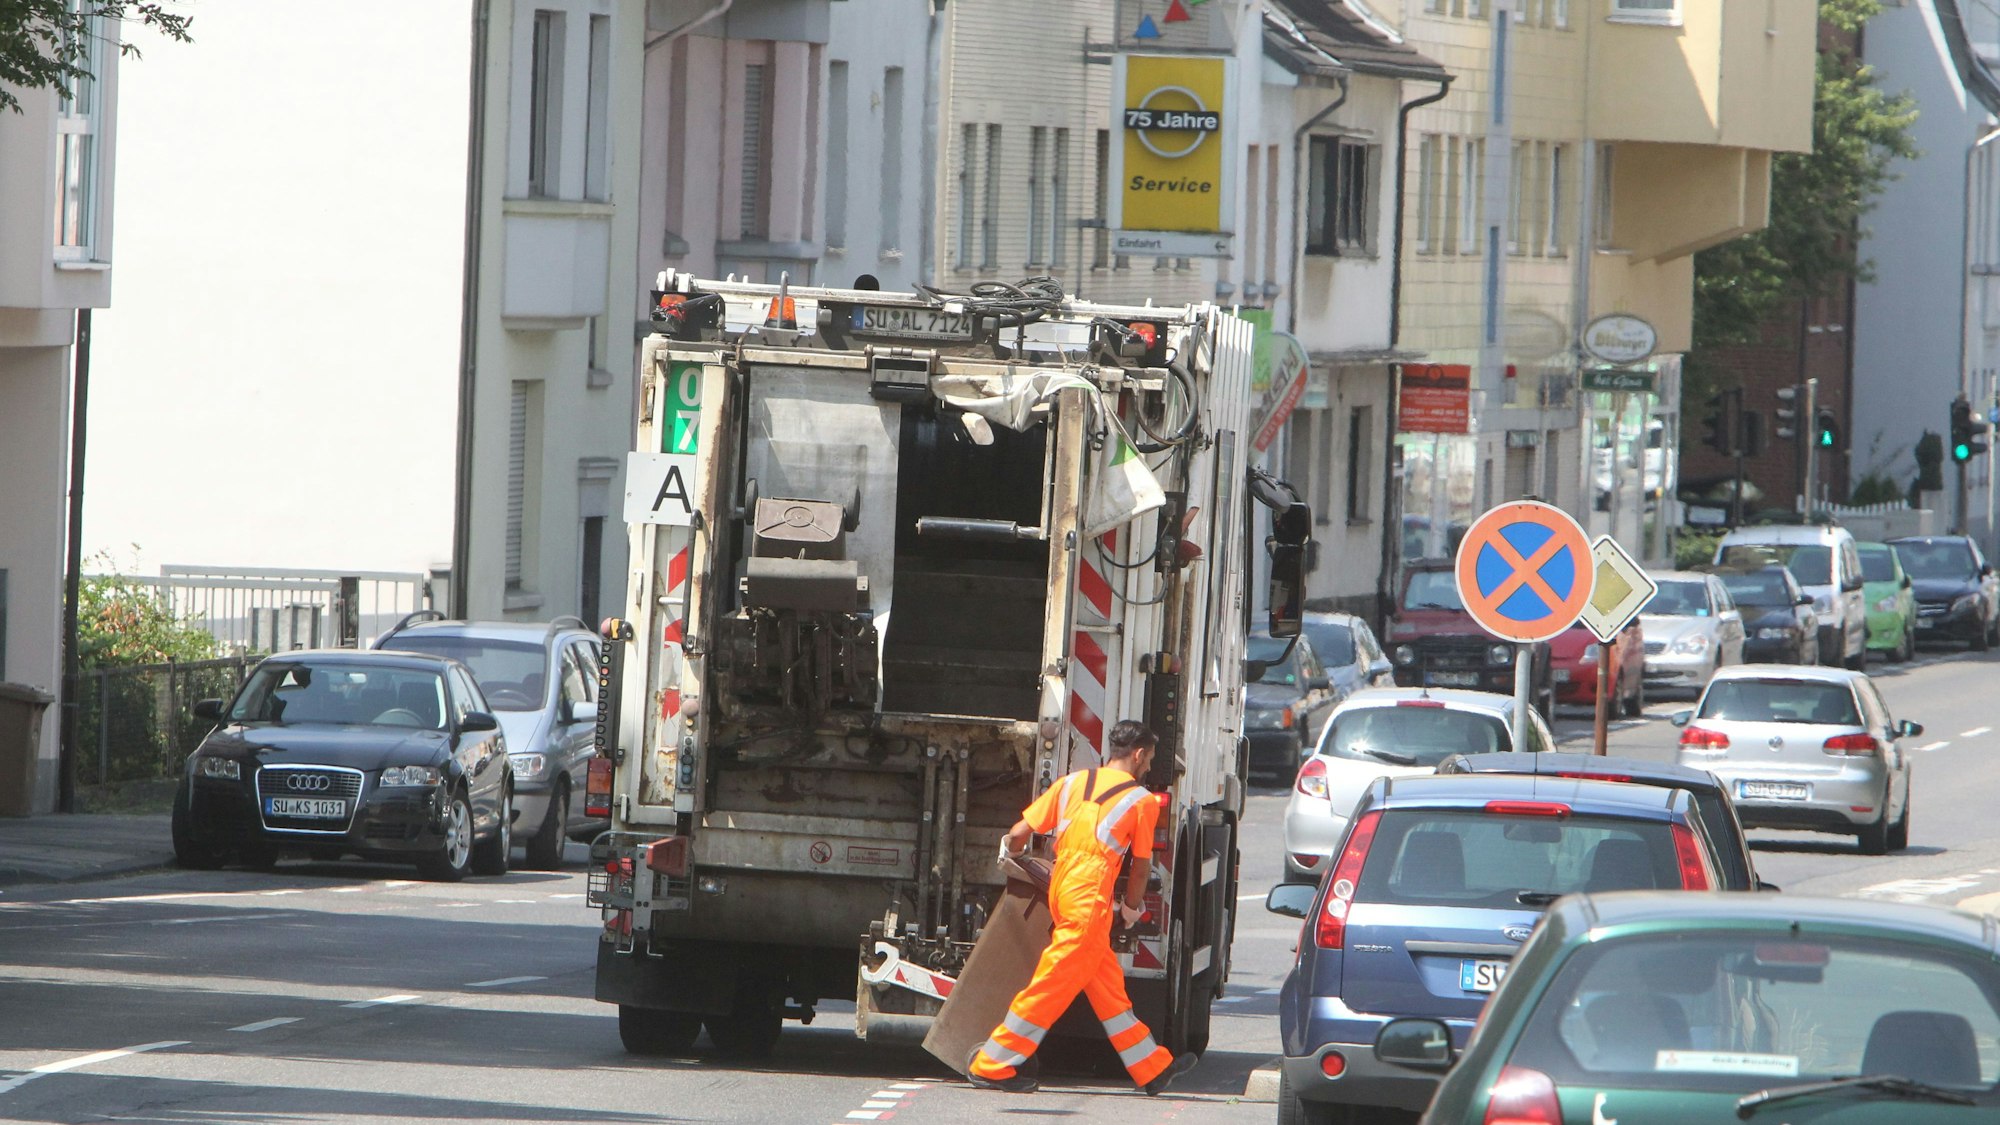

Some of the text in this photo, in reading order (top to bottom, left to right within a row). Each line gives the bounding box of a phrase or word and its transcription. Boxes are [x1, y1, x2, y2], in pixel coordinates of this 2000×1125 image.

[1127, 111, 1218, 129] 75 Jahre
[1130, 176, 1212, 193] Service
[1118, 238, 1161, 249] Einfahrt
[865, 309, 971, 335] SU AL 7124
[652, 465, 692, 514] A
[273, 801, 343, 815] SU KS 1031
